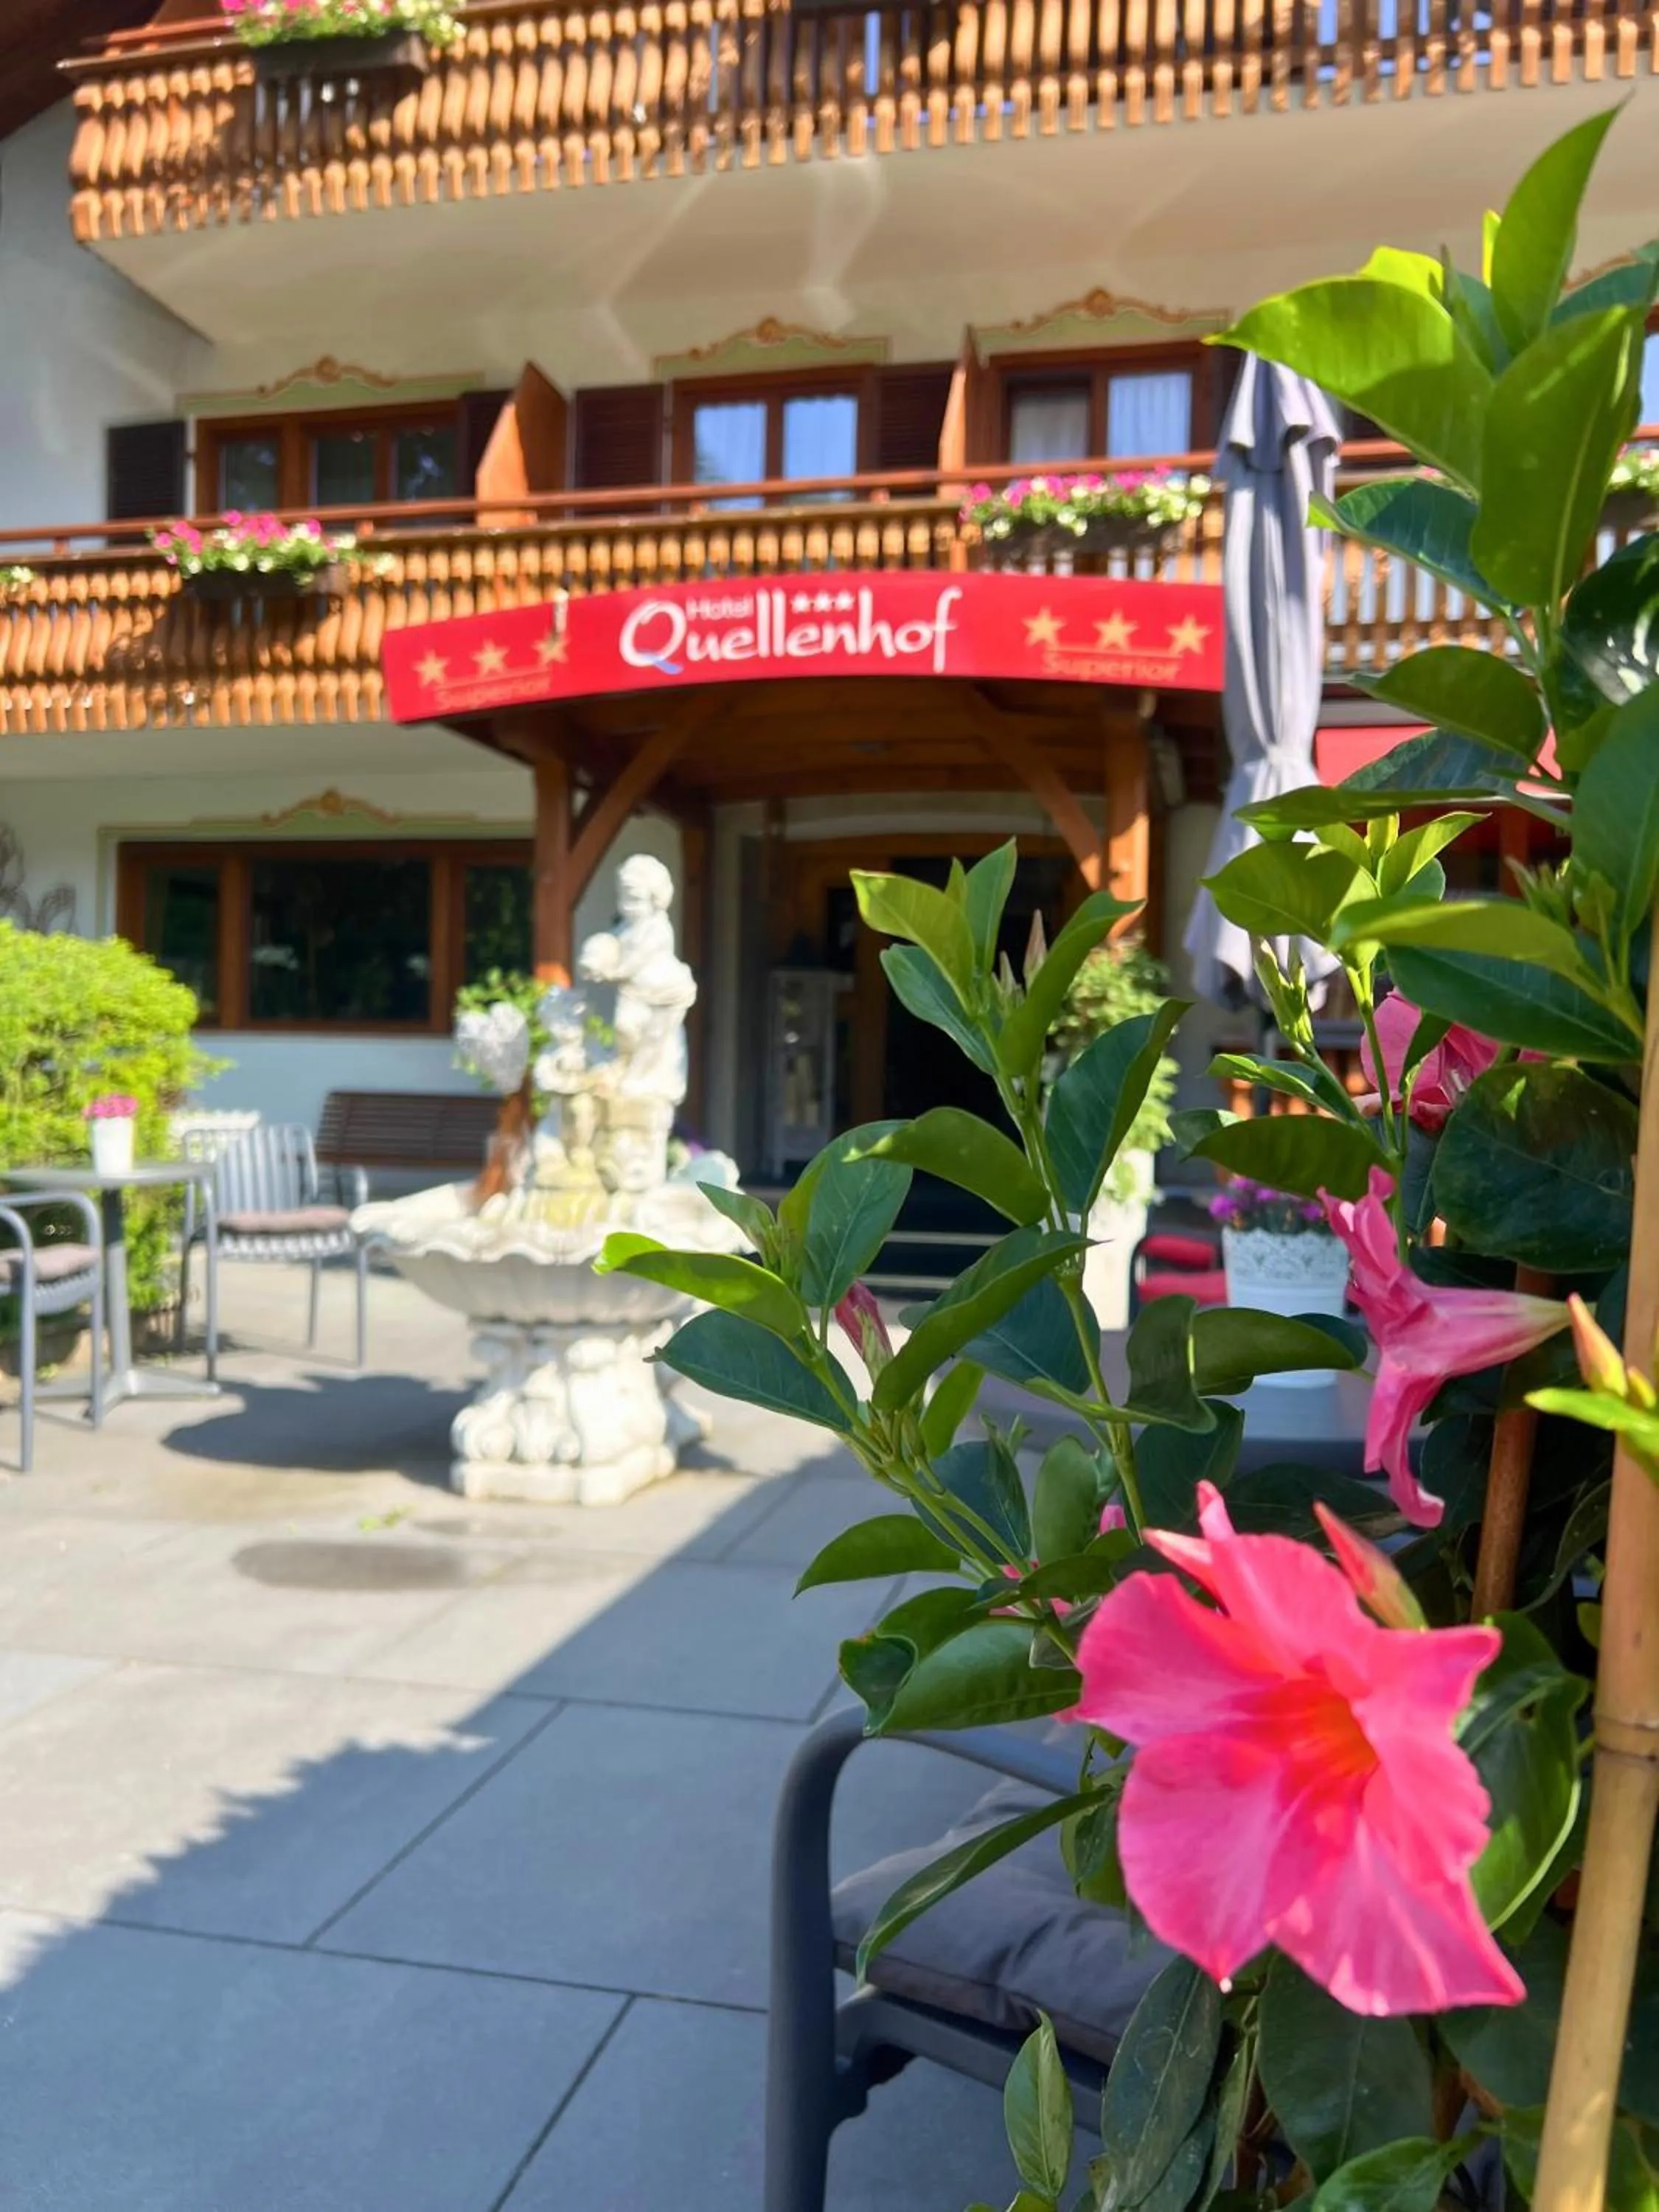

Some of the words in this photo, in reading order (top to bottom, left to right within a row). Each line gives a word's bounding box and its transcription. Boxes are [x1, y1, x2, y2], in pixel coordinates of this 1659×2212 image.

[686, 597, 754, 621] Hotel
[619, 586, 963, 675] Quellenhof
[1042, 650, 1179, 682] Superior
